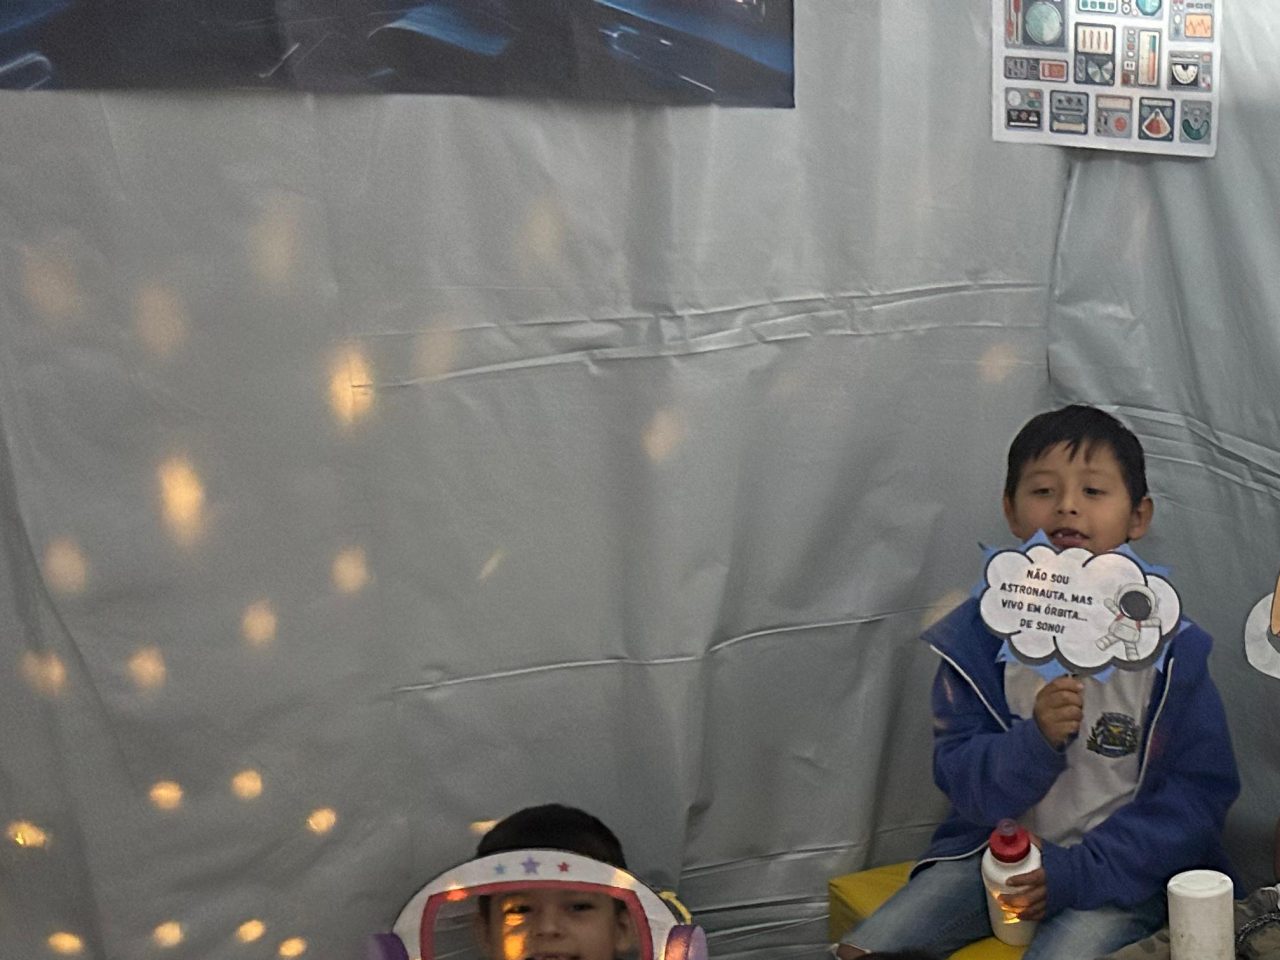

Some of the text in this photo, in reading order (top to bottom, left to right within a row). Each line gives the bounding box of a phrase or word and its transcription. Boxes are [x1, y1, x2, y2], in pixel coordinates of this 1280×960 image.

[1026, 568, 1069, 584] NÃO SOU
[1000, 582, 1093, 605] ASTRONAUTA, MAS
[1001, 599, 1088, 621] VIVO EM ÓRBITA...
[1020, 618, 1065, 634] DE SONO!
